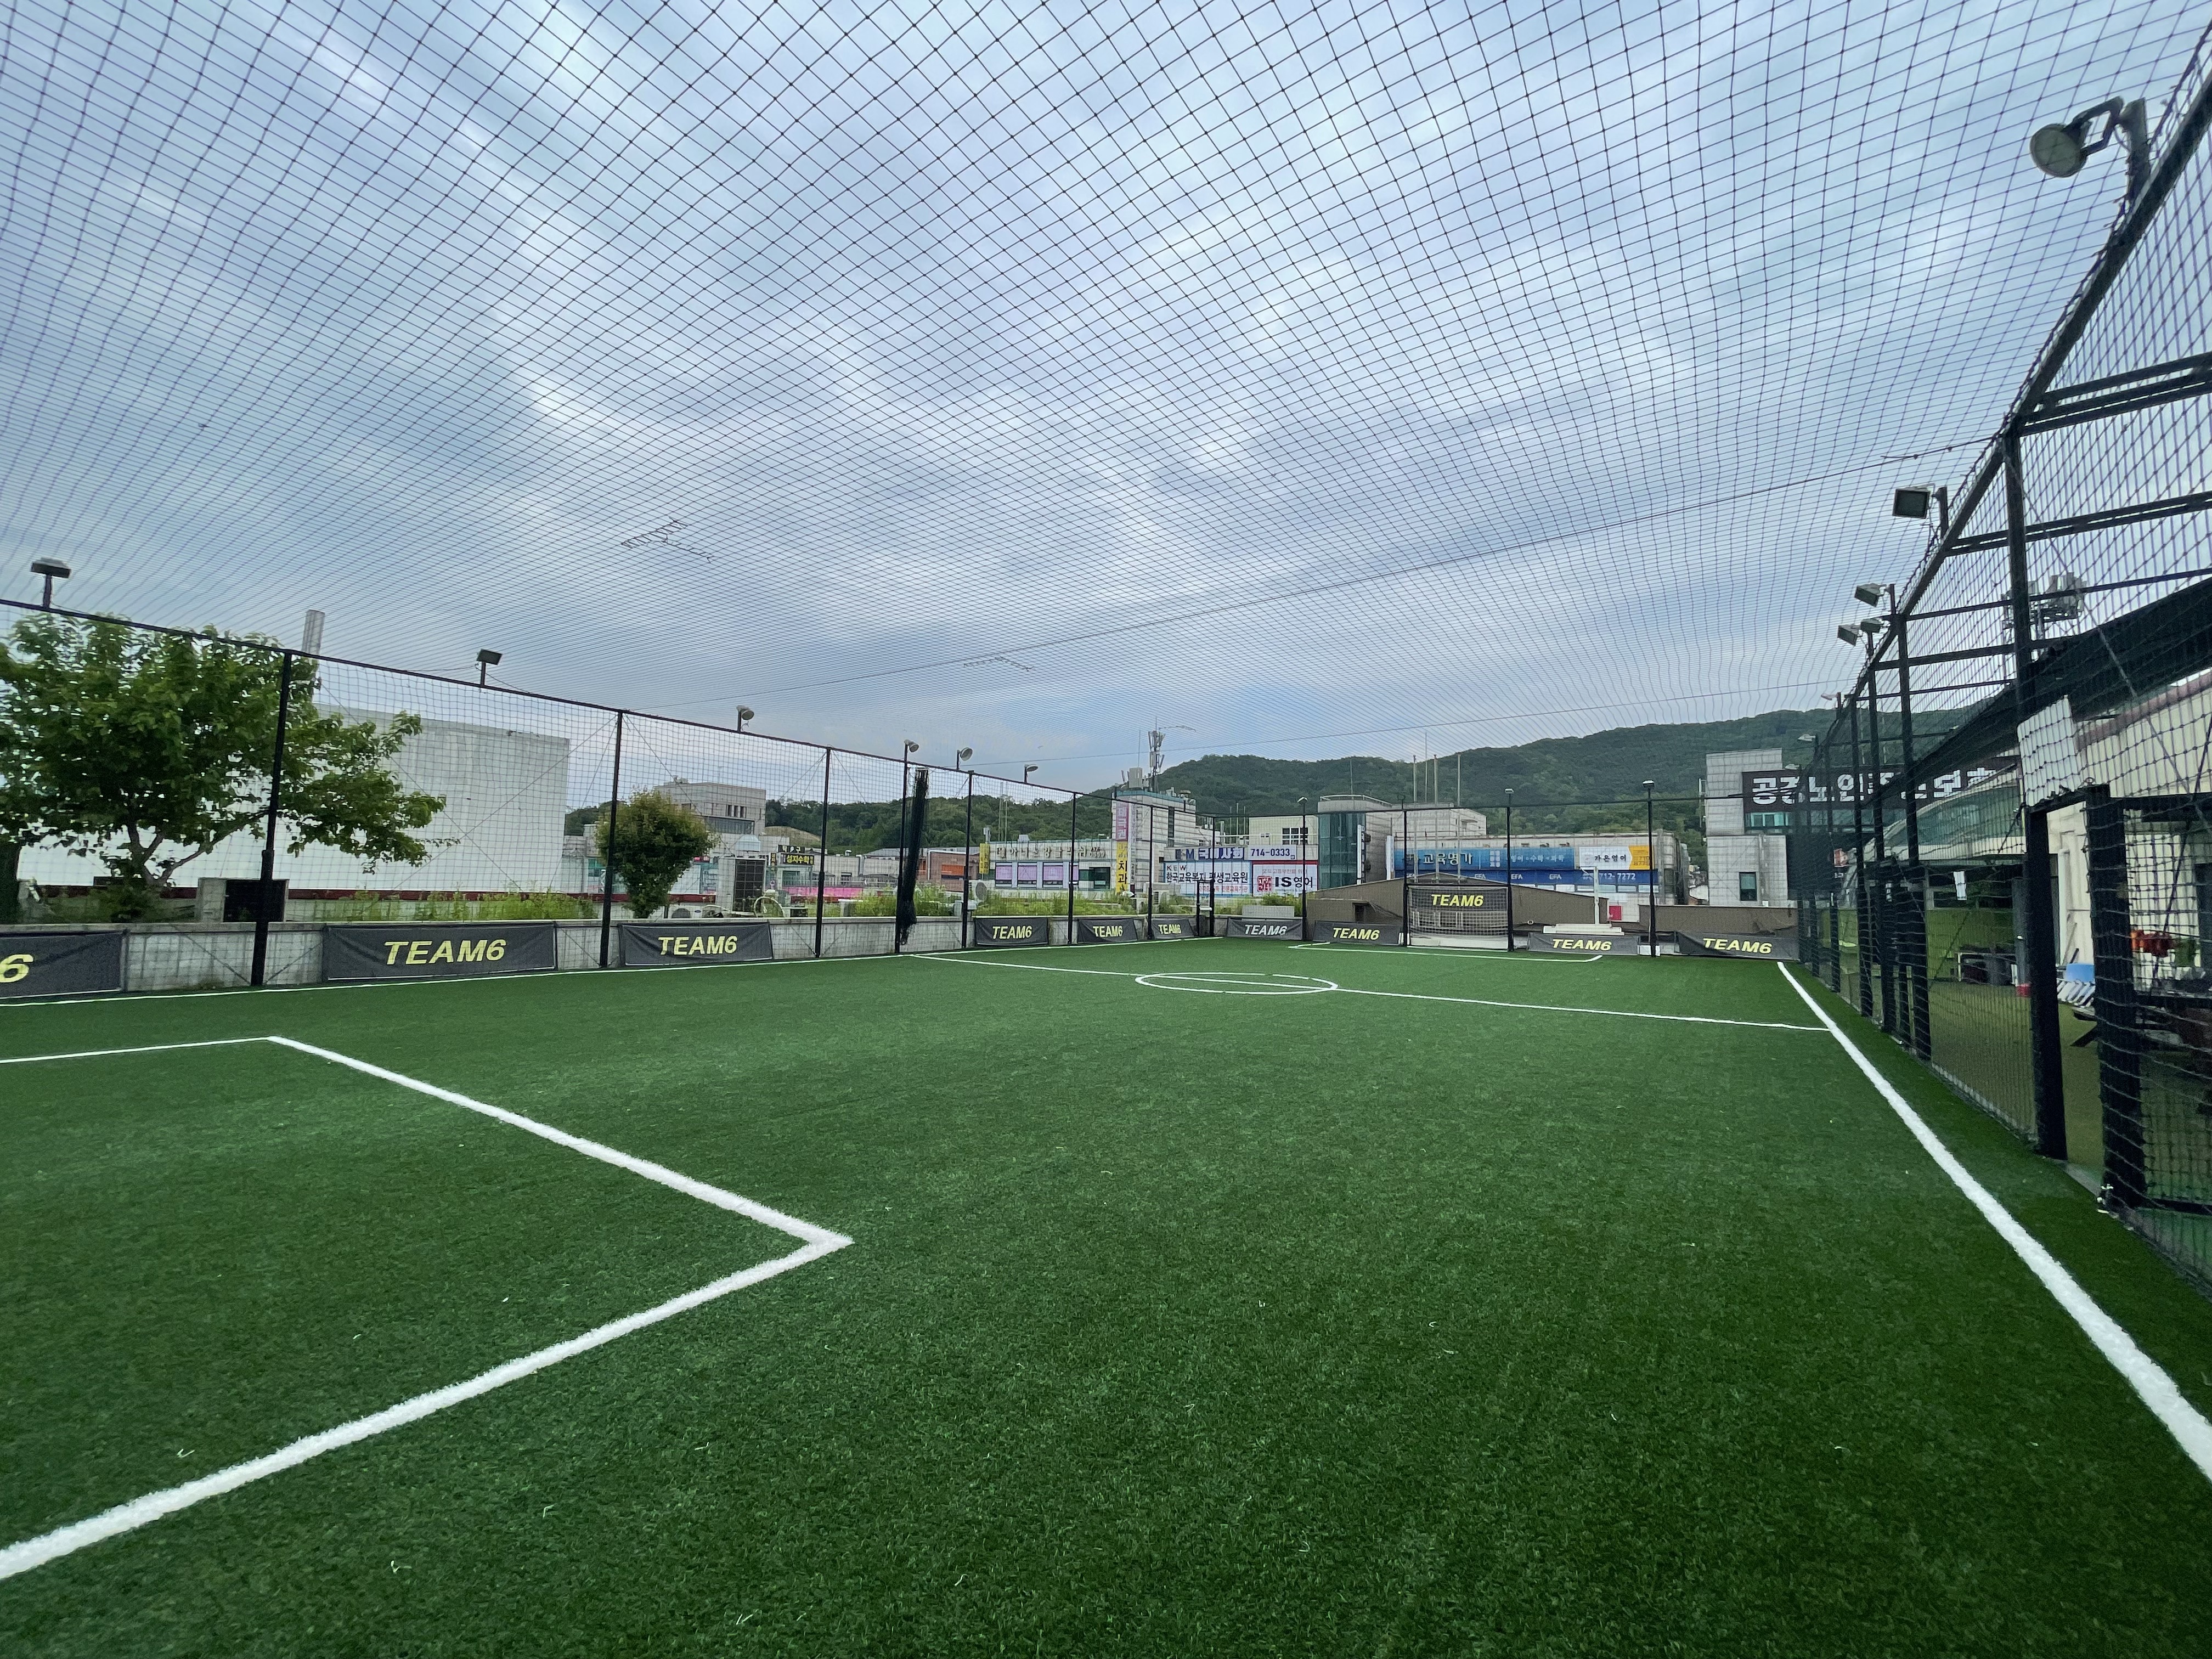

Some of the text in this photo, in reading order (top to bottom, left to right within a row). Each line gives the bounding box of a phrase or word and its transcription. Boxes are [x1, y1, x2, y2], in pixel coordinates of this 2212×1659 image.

[787, 855, 810, 864] 성지수학
[1423, 852, 1472, 865] 교육명가
[1118, 860, 1127, 884] 치과
[1166, 872, 1248, 884] 한국교육복지 평생교육원
[1431, 894, 1483, 907] TEAM6
[993, 926, 1032, 939] TEAM6
[1093, 926, 1123, 938] TEAM6
[1158, 924, 1182, 934] TEAM6
[1245, 924, 1287, 935] TEAM6
[1334, 927, 1380, 940] TEAM6
[658, 936, 738, 955] TEAM6
[1553, 939, 1612, 951] TEAM6
[1703, 938, 1772, 953] TEAM6
[385, 939, 506, 965] TEAM6
[0, 954, 33, 983] 6
